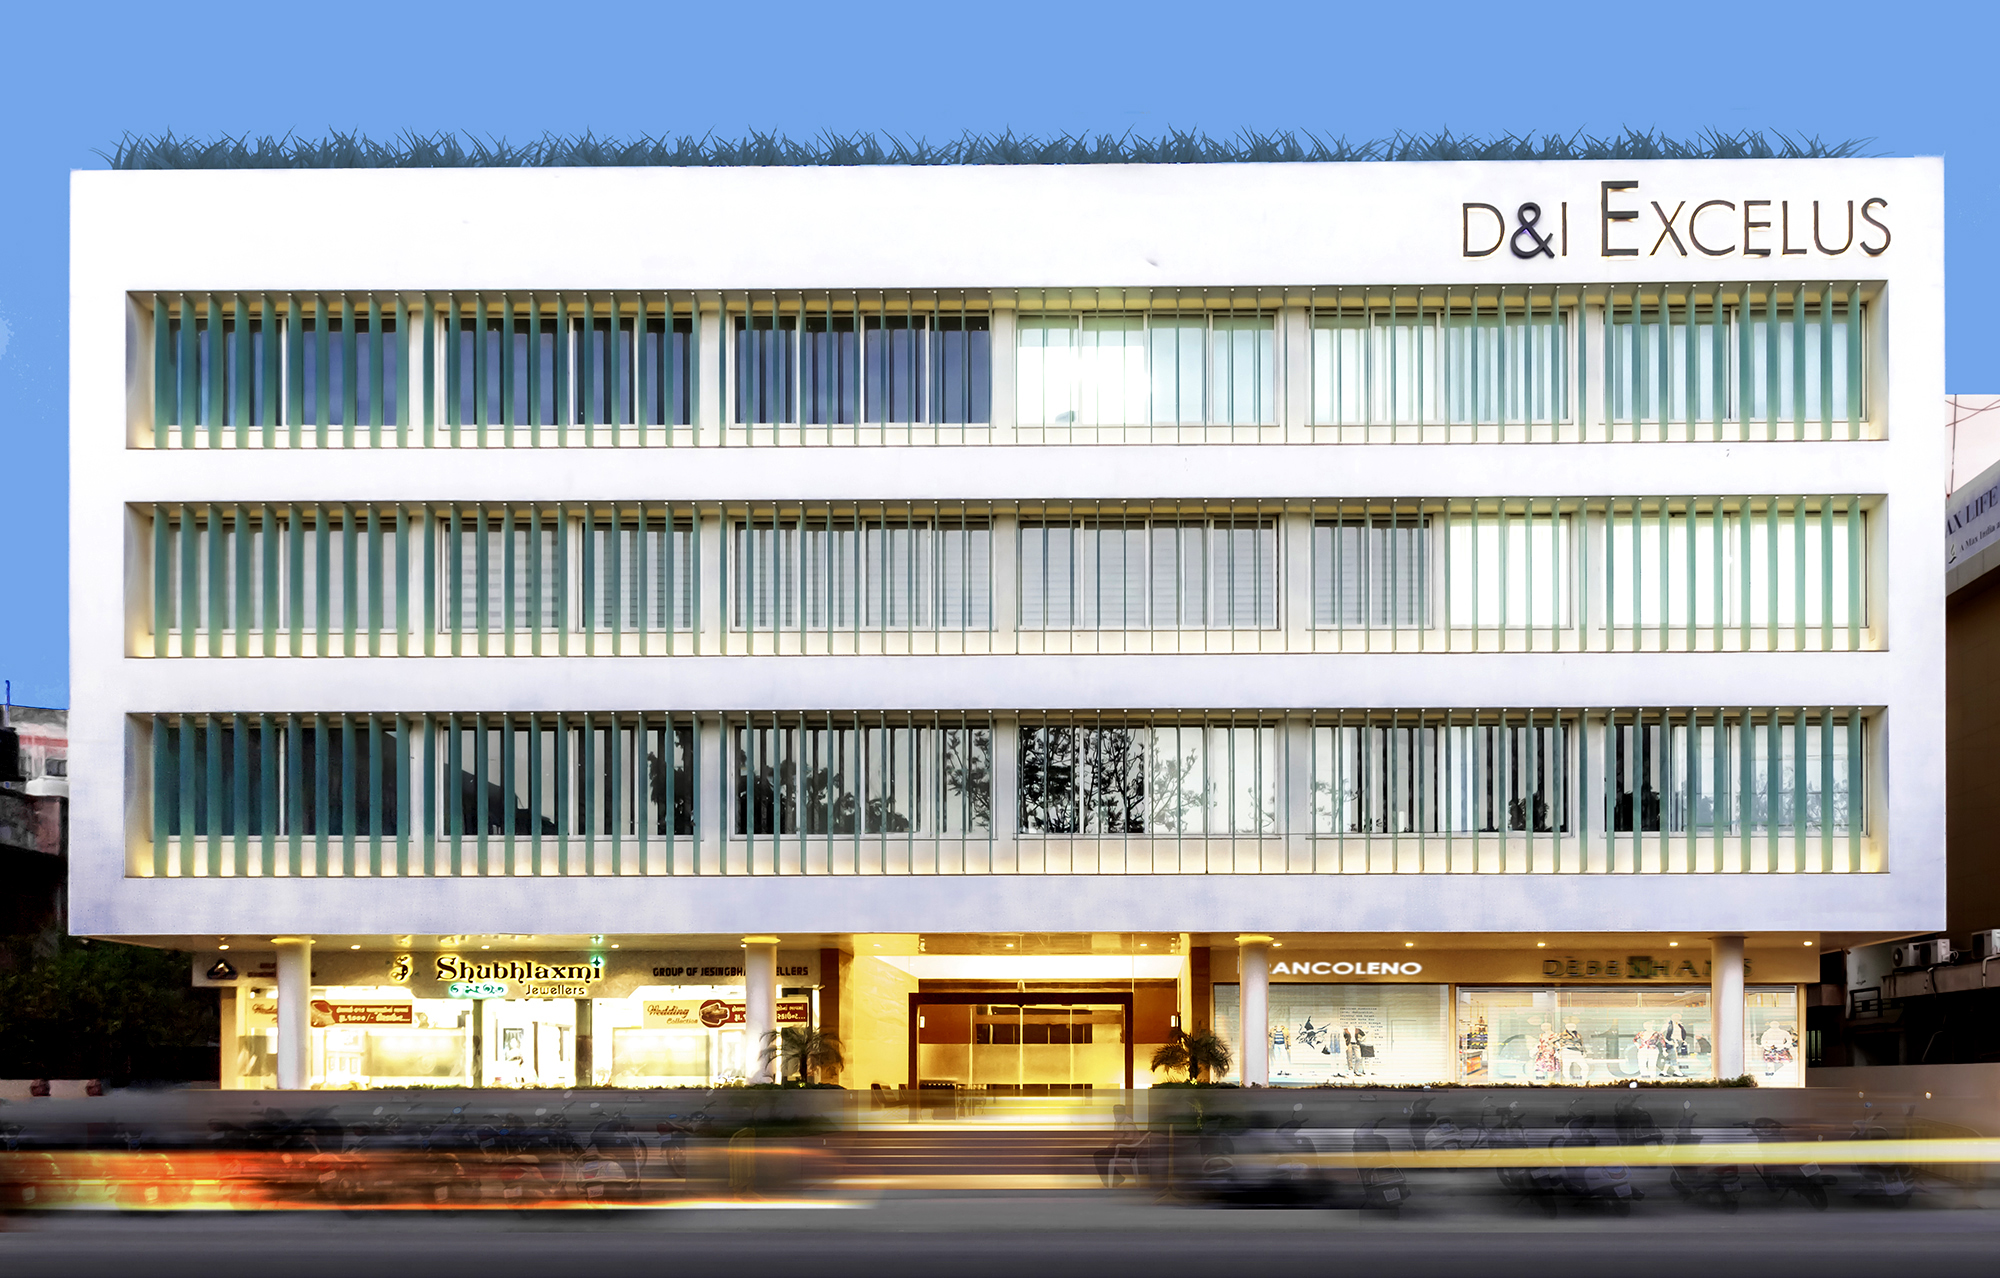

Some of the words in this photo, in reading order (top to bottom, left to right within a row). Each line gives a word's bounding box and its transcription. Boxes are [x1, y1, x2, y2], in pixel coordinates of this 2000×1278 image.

[1463, 202, 1567, 259] D&I
[1601, 180, 1891, 259] EXCELUS
[1966, 485, 1999, 524] LIFE
[436, 956, 602, 984] Shubhlaxmi
[652, 967, 683, 977] GROUP
[686, 967, 698, 977] OF
[701, 967, 746, 977] JESINGBH
[1236, 961, 1423, 975] ANCOLENO
[525, 984, 586, 996] Jewellers
[647, 1004, 690, 1019] Wedding
